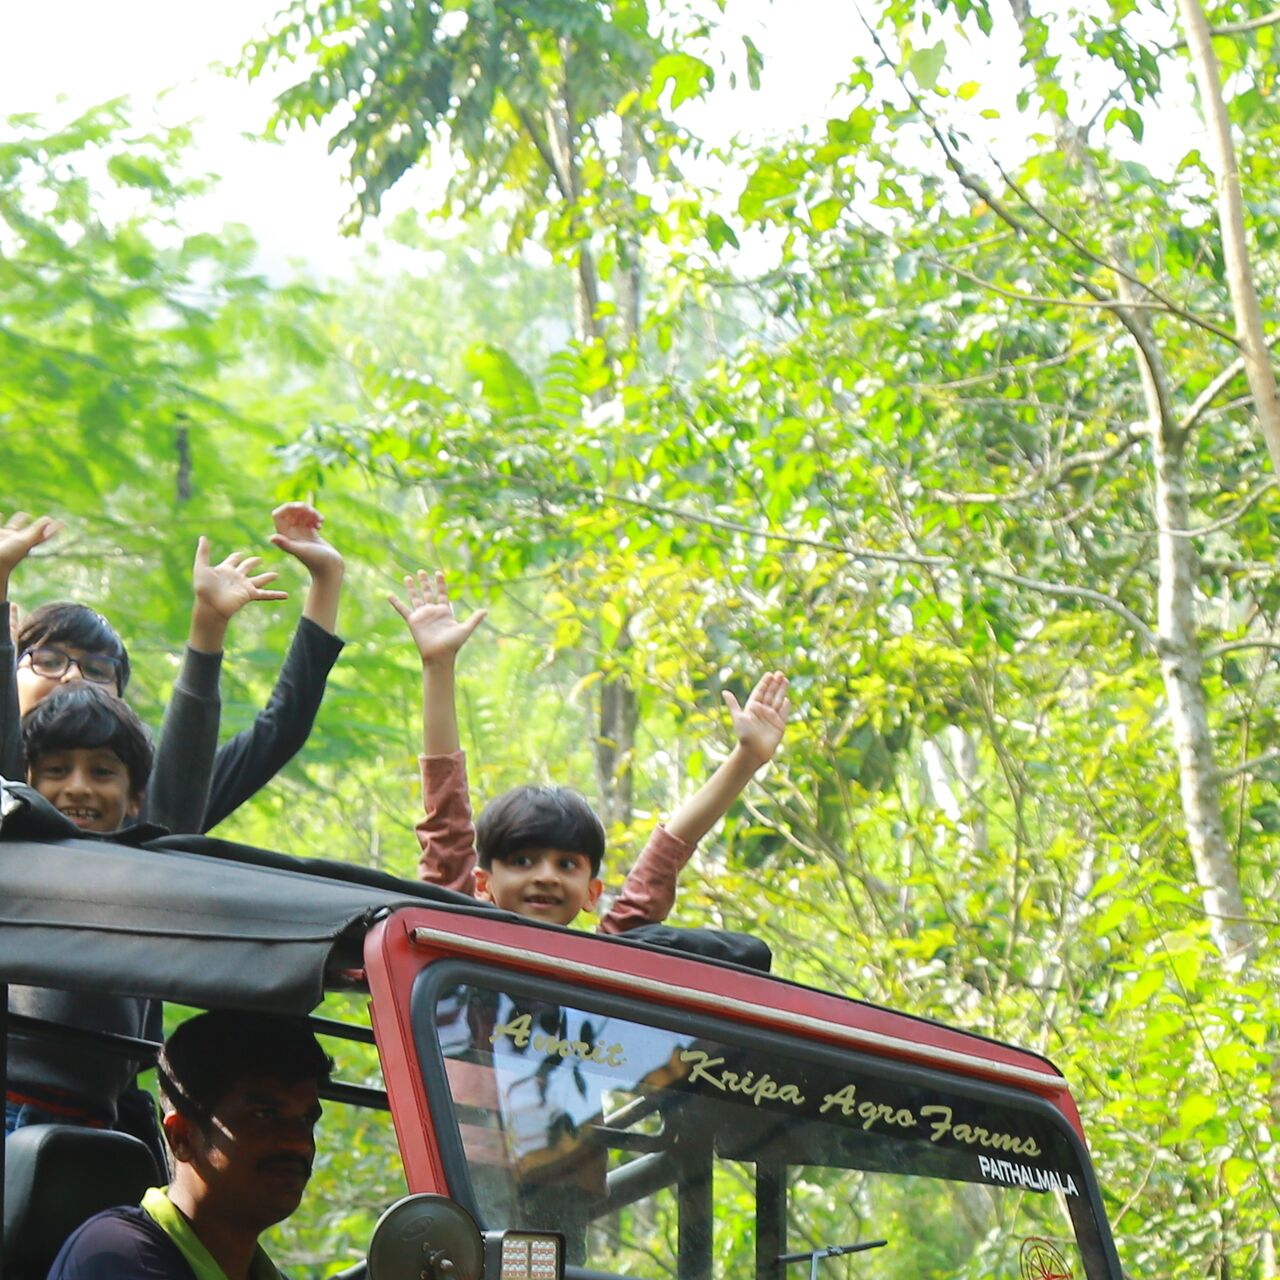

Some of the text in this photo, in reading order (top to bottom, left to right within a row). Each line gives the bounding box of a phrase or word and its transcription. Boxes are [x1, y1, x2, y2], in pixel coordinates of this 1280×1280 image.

[488, 1013, 1043, 1158] Amrit Kripa Agro Farms
[976, 1153, 1081, 1197] PAITHALMALA
